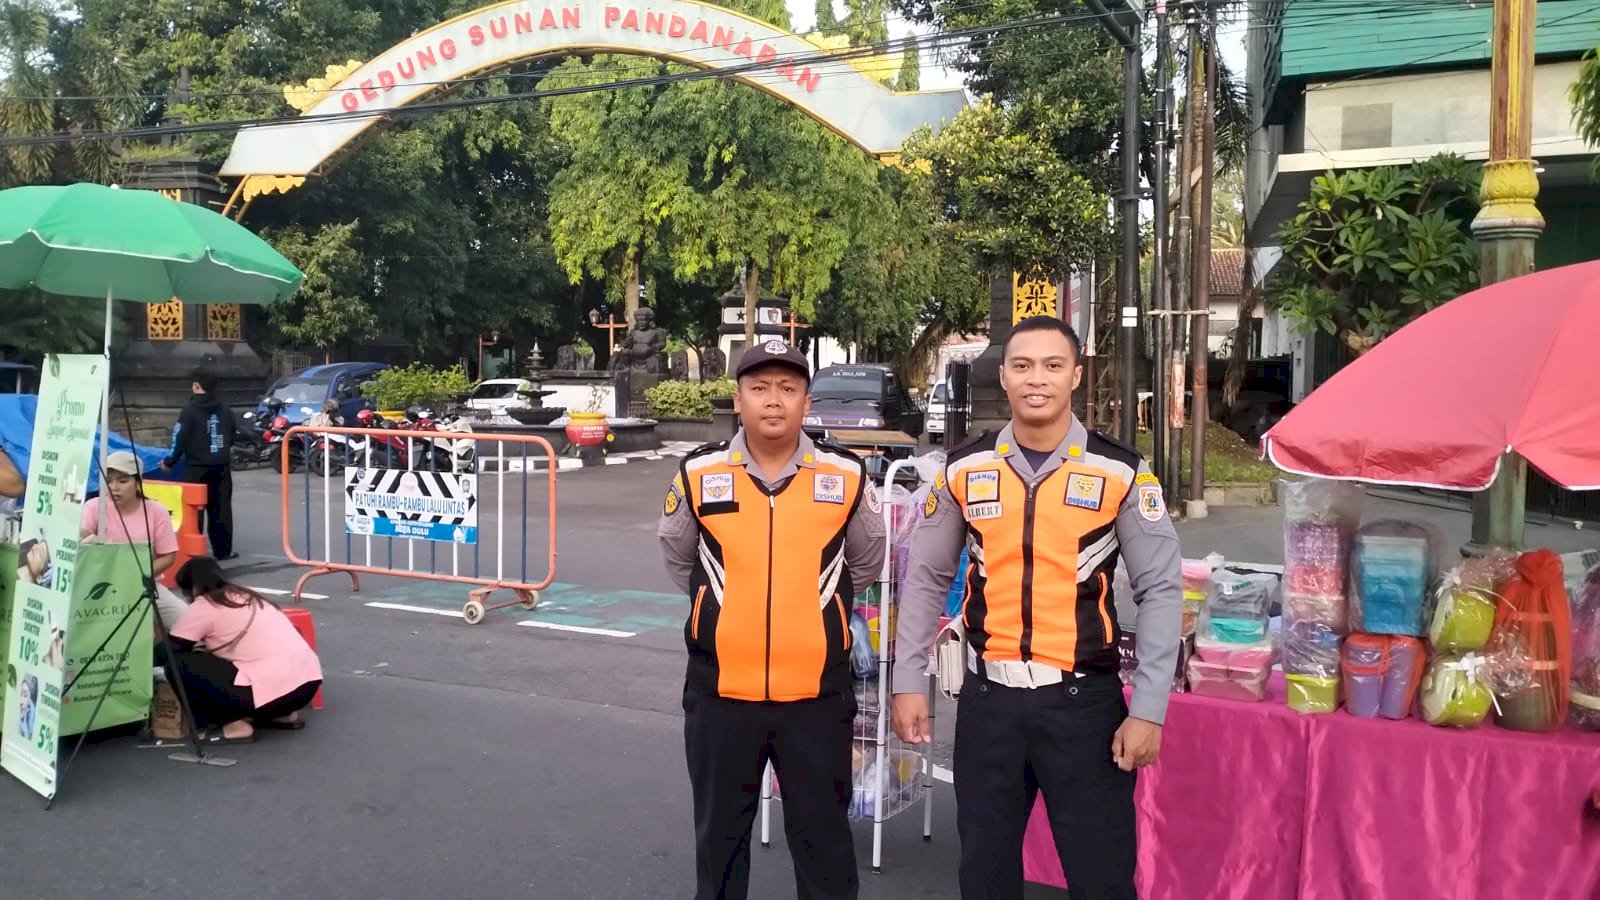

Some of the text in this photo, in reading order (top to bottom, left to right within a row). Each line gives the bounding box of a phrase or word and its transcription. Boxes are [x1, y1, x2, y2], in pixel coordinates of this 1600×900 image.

[341, 6, 821, 113] GEDUNG SUNAN PANDANARAN
[56, 389, 85, 421] Promo
[36, 490, 53, 516] 5%
[355, 493, 465, 515] PATUHI RAMBU-RAMBU LALU LINTAS
[815, 493, 843, 502] DISHUB
[1067, 496, 1098, 508] DISHUB
[967, 505, 999, 518] ALBERT
[19, 636, 39, 667] 10%
[37, 724, 54, 755] 5%
